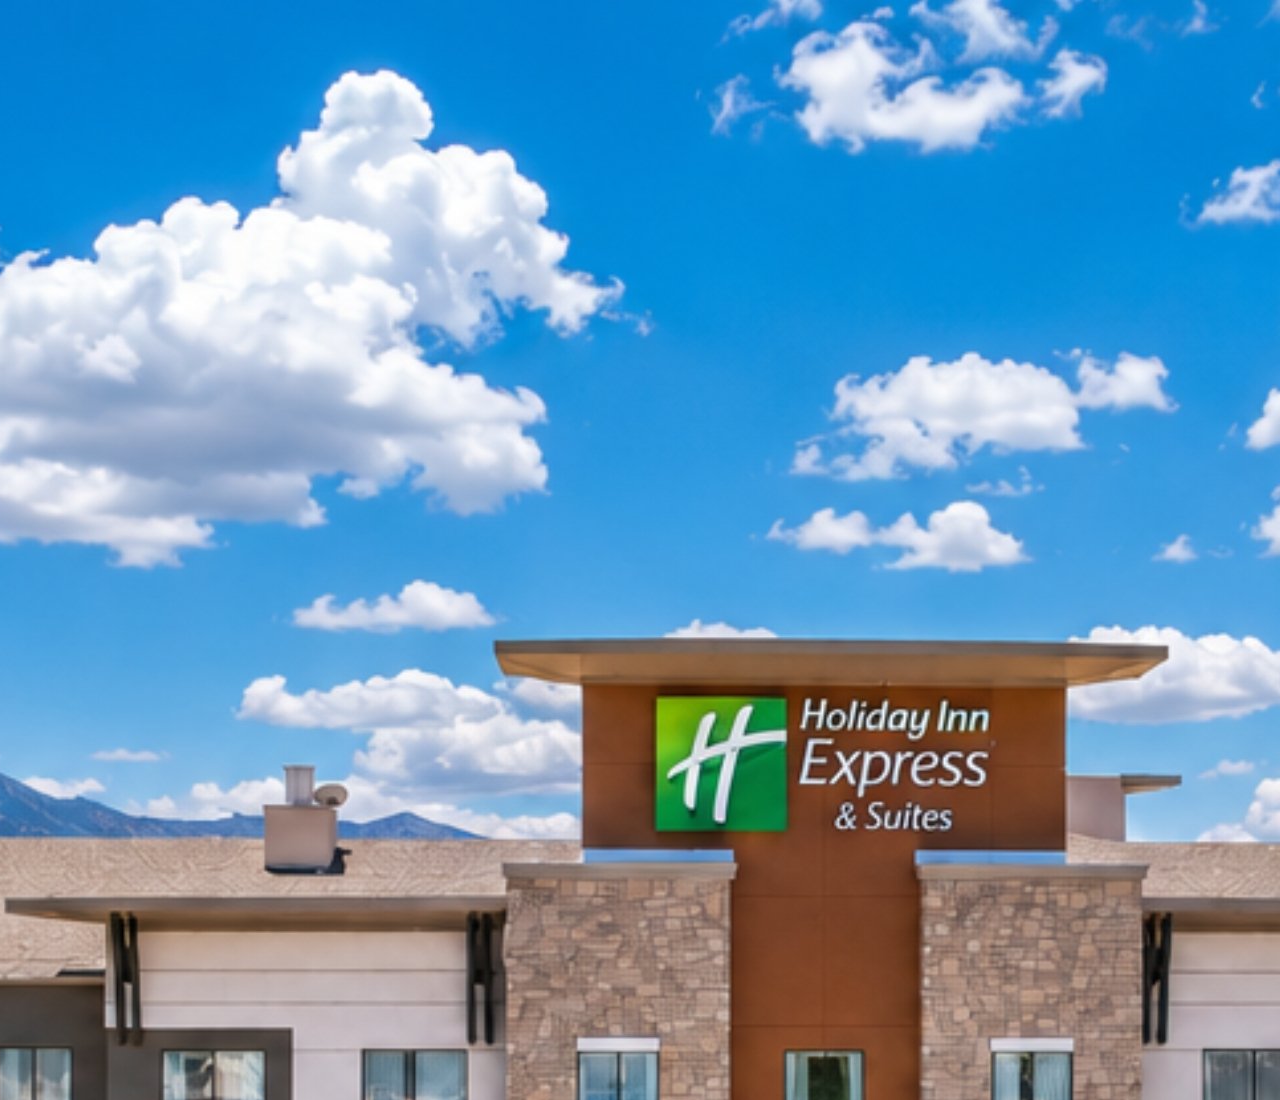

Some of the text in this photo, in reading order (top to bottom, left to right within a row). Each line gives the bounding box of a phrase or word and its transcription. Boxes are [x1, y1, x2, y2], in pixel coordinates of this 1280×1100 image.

[800, 698, 990, 740] Holiday Inn
[799, 738, 989, 798] Express
[834, 801, 953, 830] & Suites
